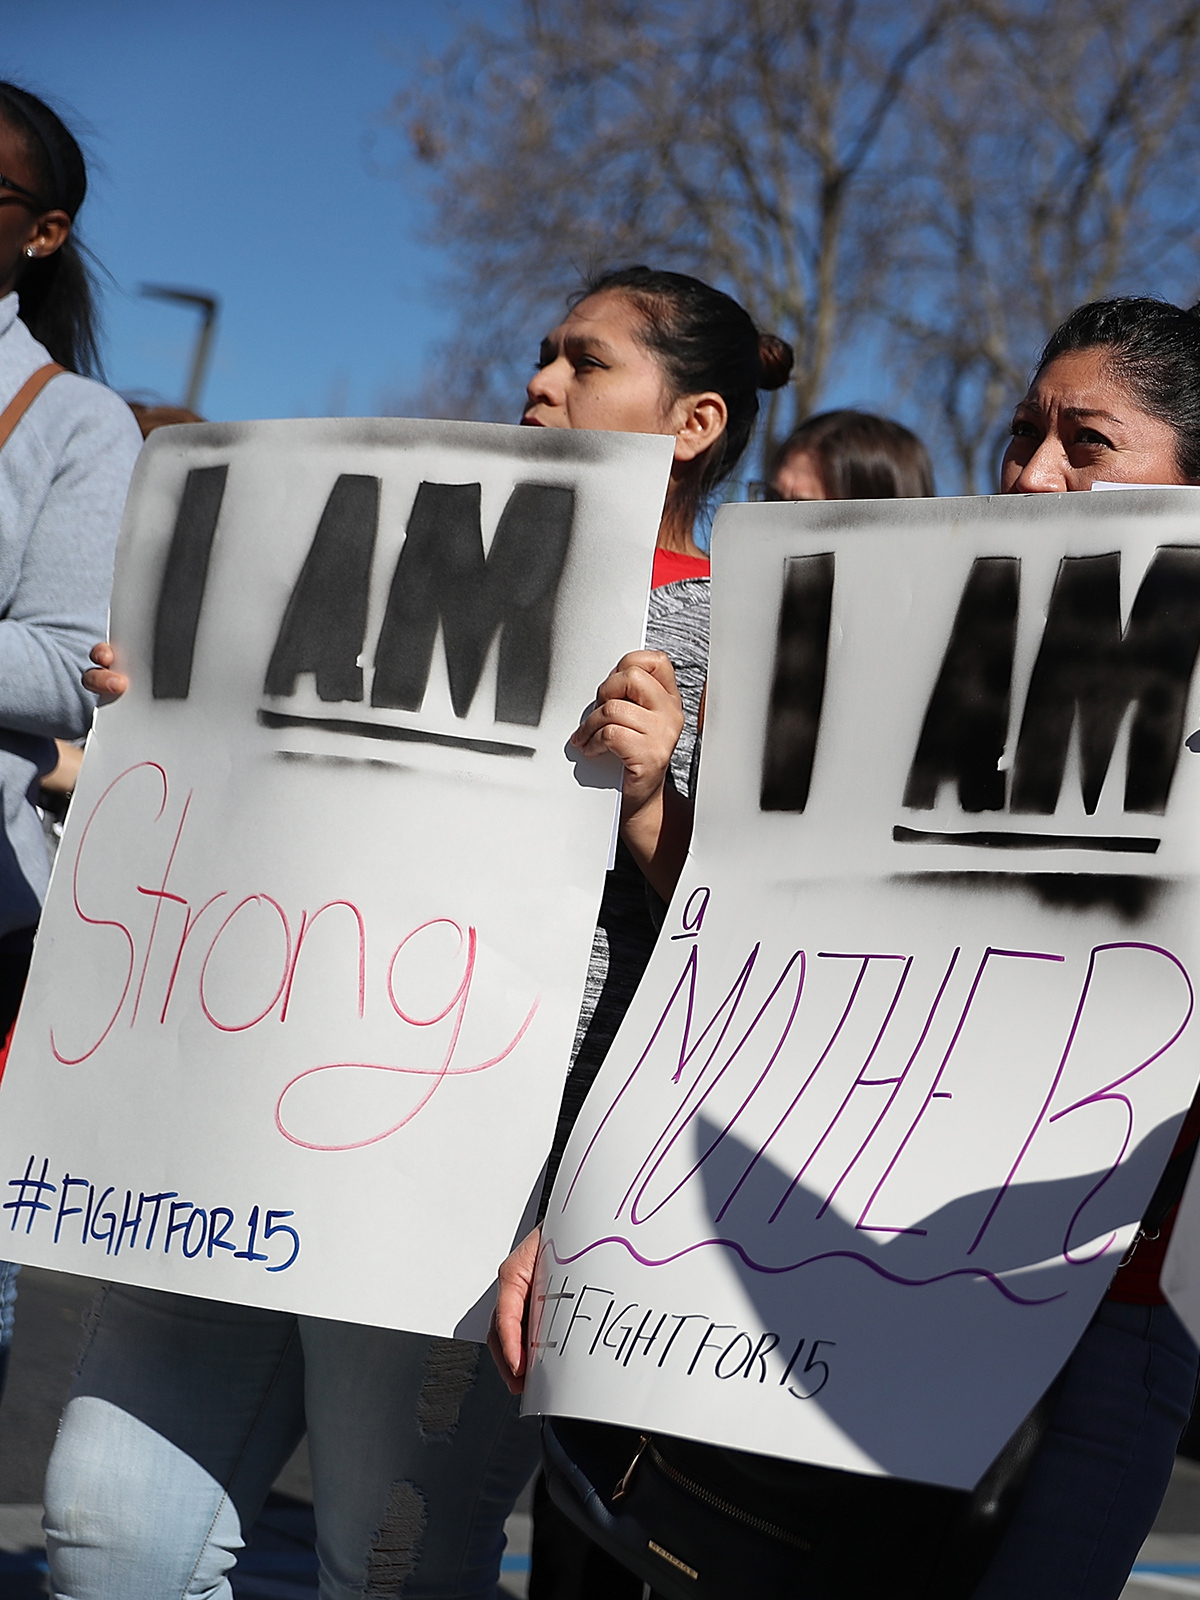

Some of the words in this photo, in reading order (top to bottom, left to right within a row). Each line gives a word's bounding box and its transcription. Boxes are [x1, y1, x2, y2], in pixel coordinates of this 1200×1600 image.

[152, 463, 229, 699] I
[263, 473, 577, 727] AM
[760, 551, 836, 815] I
[50, 759, 542, 1152] Strong
[681, 886, 711, 931] a
[3, 1155, 300, 1273] #FIGHTFOR15
[561, 941, 1194, 1266] MOTHER
